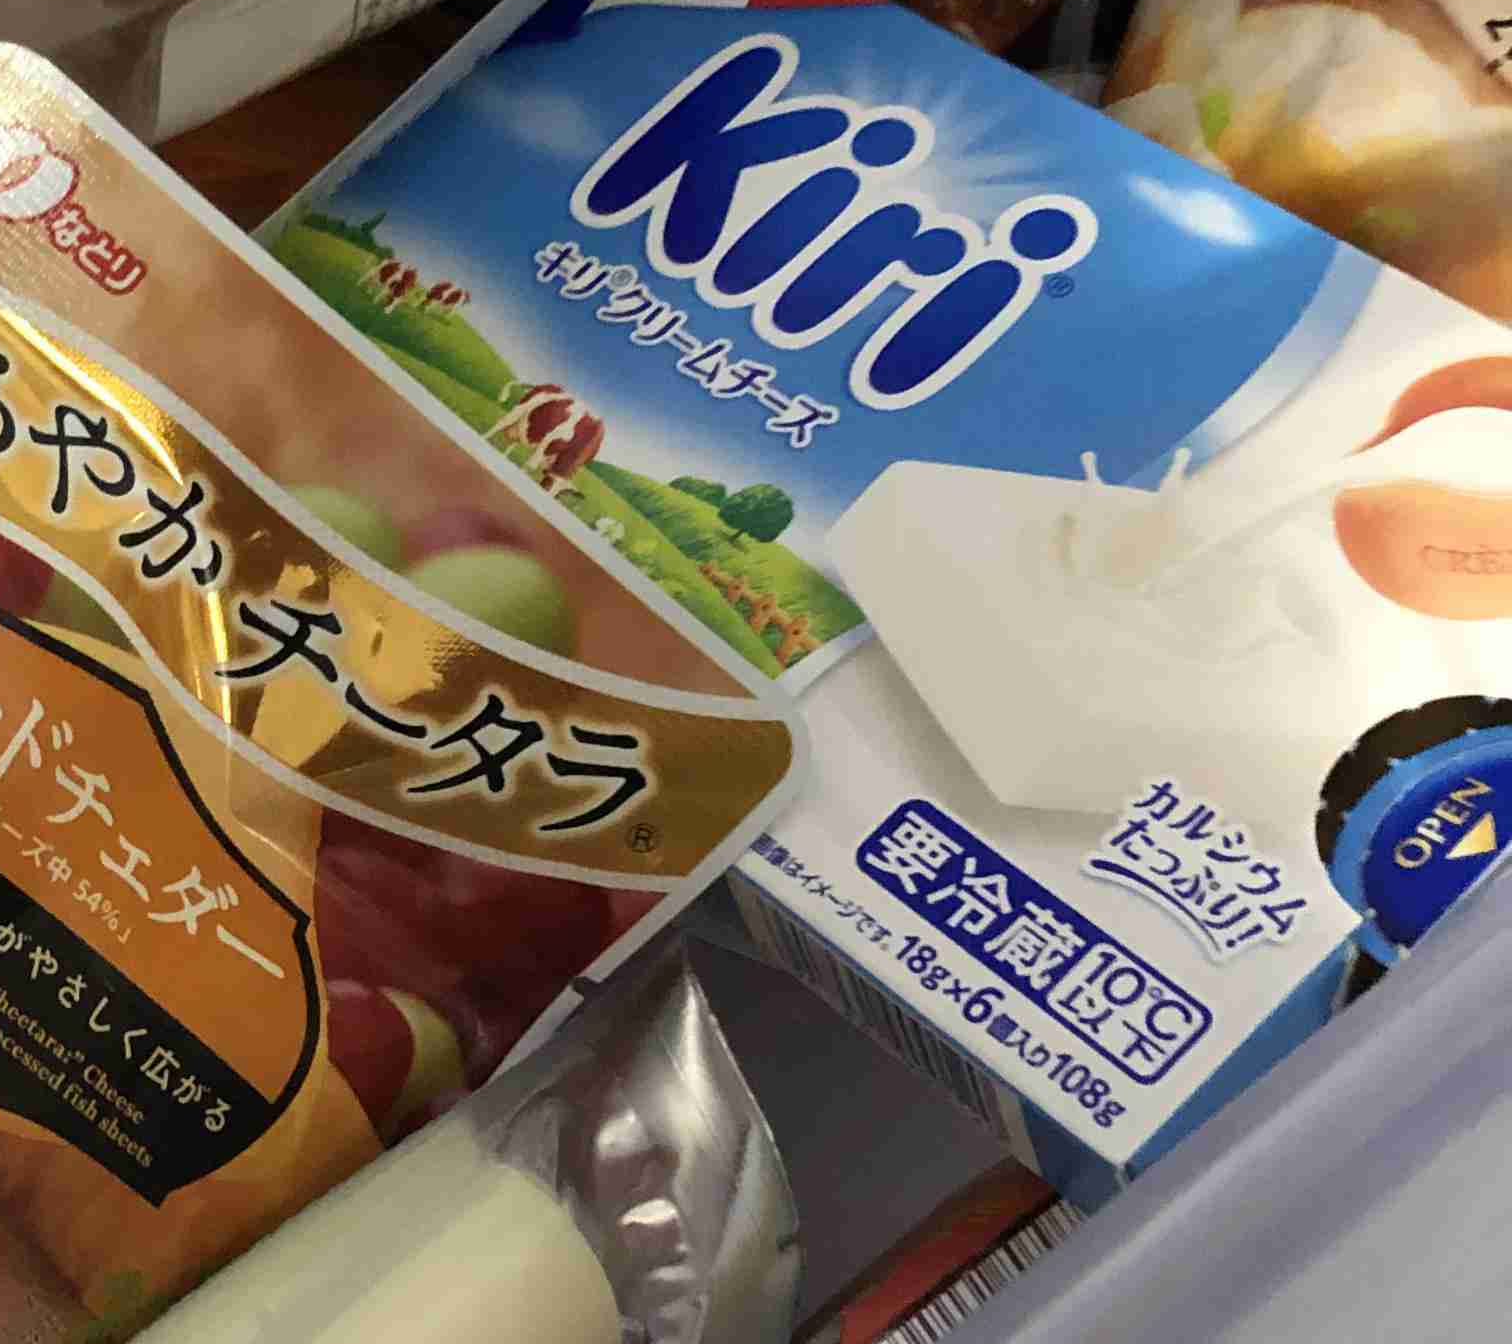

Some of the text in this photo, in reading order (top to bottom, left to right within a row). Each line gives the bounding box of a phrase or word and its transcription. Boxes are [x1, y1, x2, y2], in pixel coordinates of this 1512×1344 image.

[49, 205, 142, 291] なとり
[576, 36, 1096, 406] kiri
[1131, 776, 1310, 944] カルシウム
[1392, 776, 1494, 872] OPEN
[864, 809, 1086, 992] 要冷蔵
[1058, 986, 1166, 1068] 以下
[63, 1083, 98, 1121] fish
[98, 1116, 153, 1168] sheets
[83, 1063, 145, 1125] Cheese
